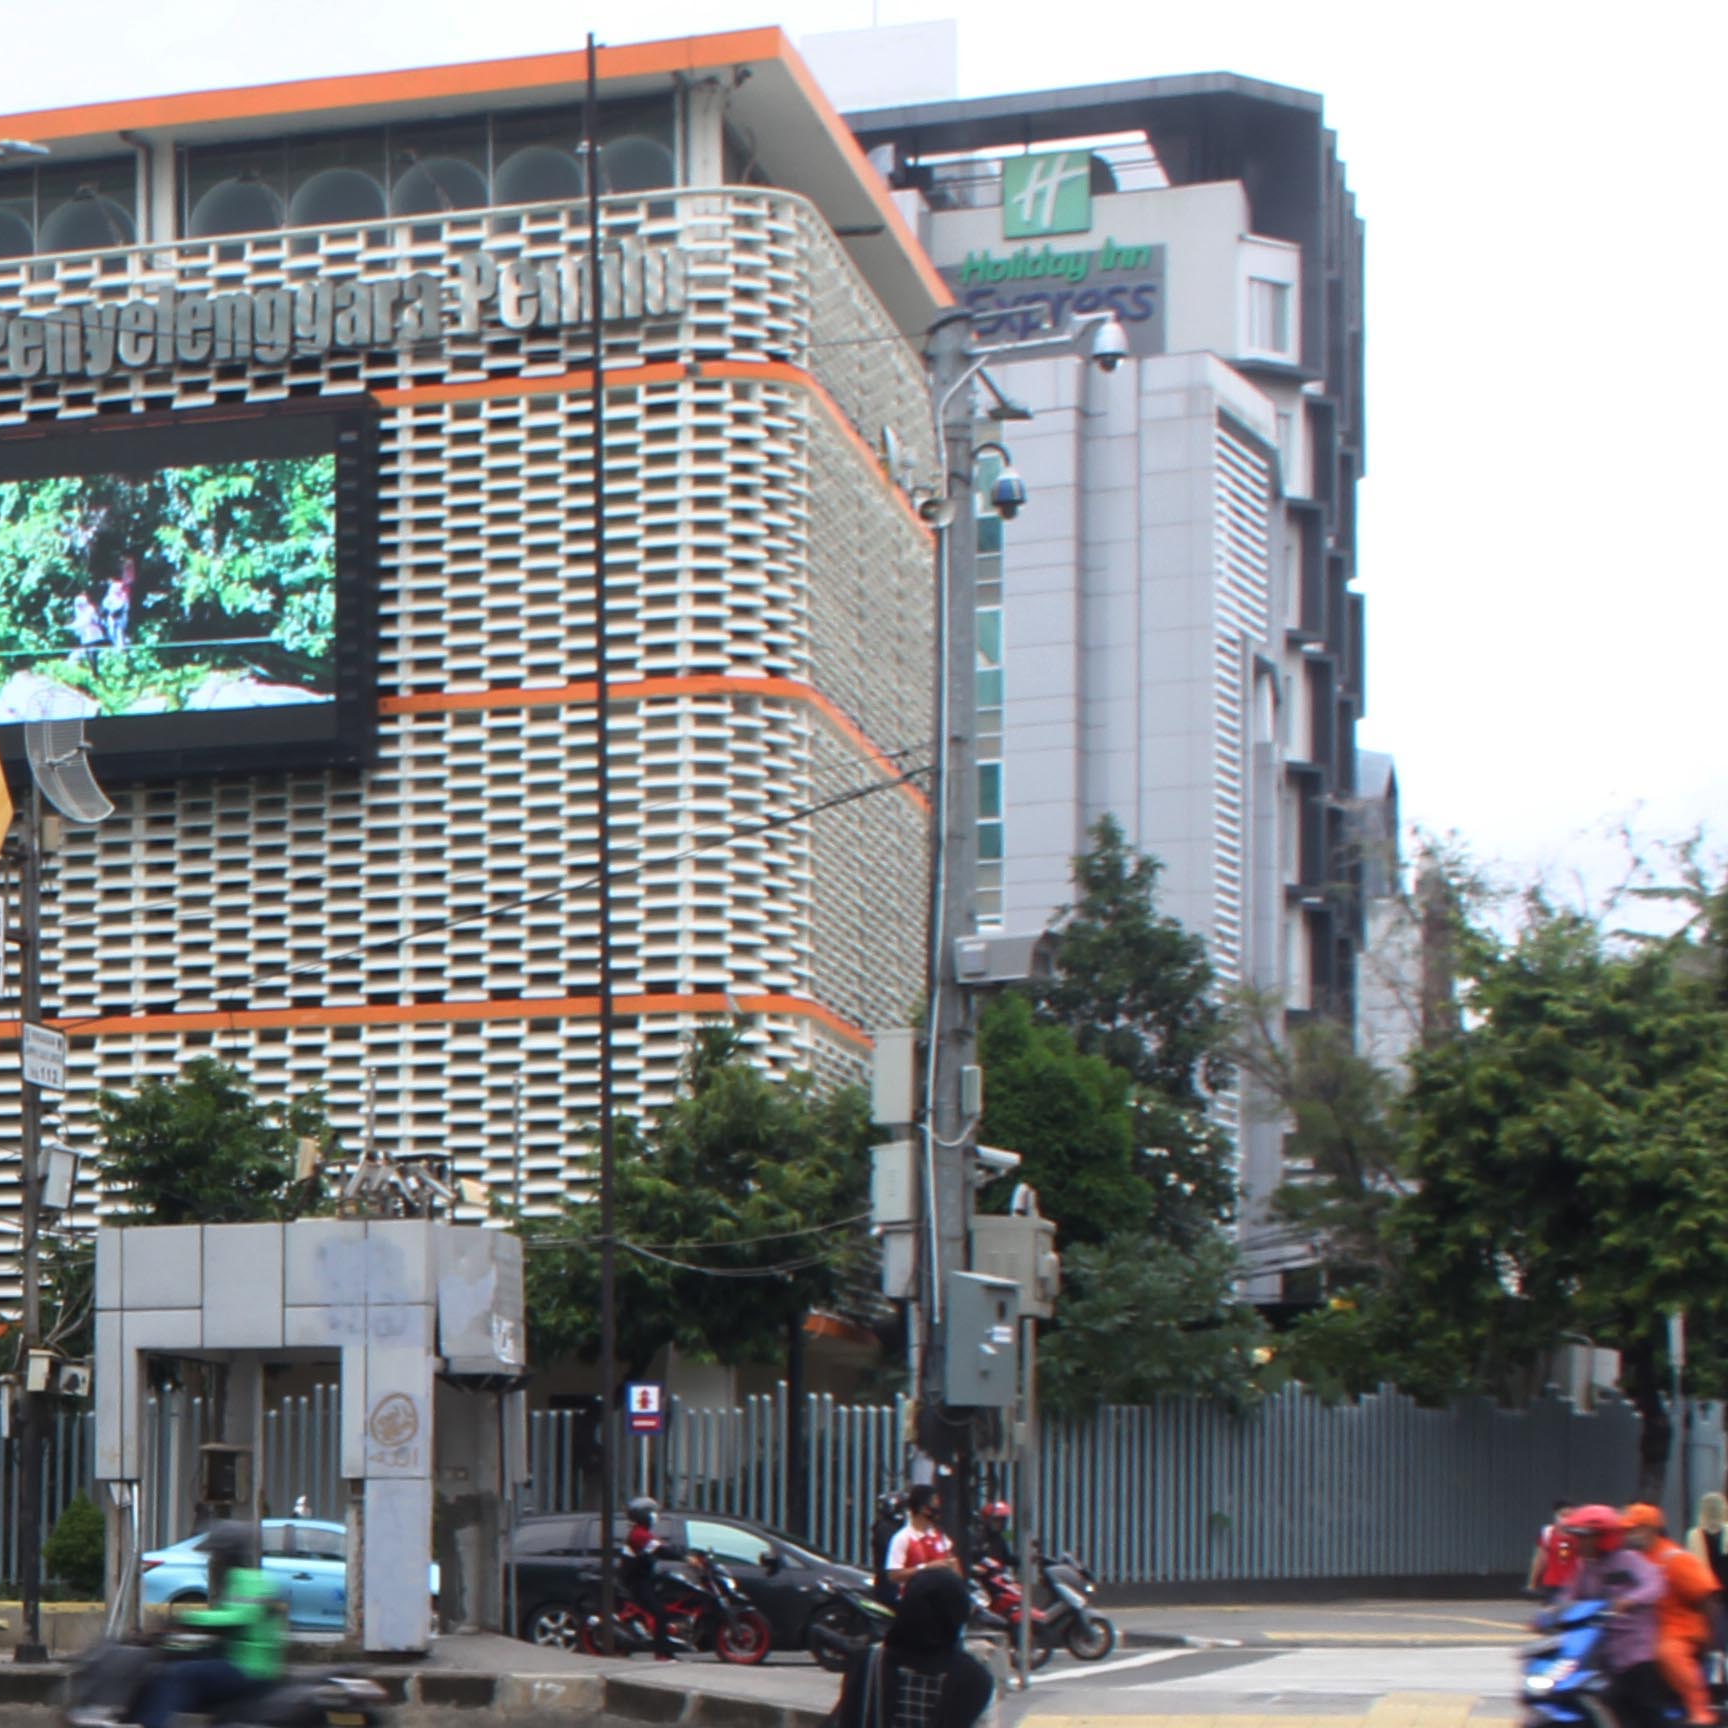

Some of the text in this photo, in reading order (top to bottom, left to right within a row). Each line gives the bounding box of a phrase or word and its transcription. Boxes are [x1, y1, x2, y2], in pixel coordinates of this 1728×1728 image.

[459, 238, 687, 333] Pemilu
[960, 235, 1152, 284] Holiday Inn
[965, 284, 1156, 339] Express
